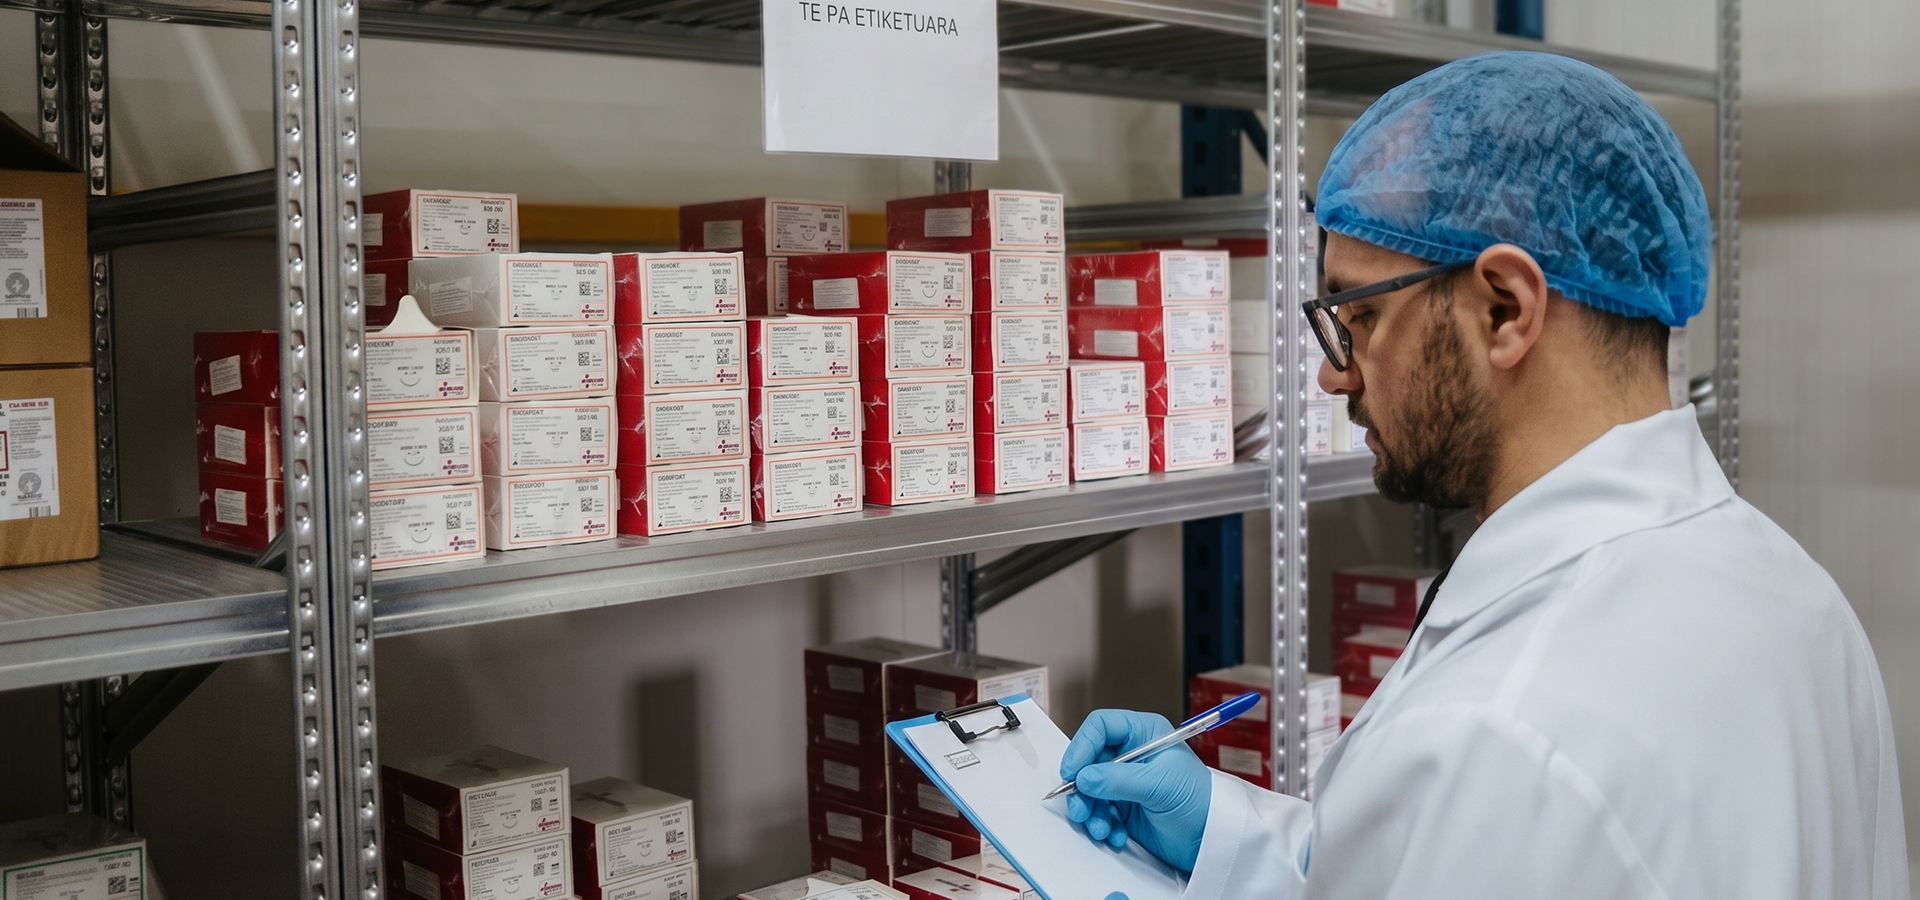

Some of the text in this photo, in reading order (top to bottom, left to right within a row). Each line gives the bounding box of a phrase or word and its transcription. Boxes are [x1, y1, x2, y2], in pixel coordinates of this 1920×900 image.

[799, 2, 958, 36] TE PA ETIKETUARA
